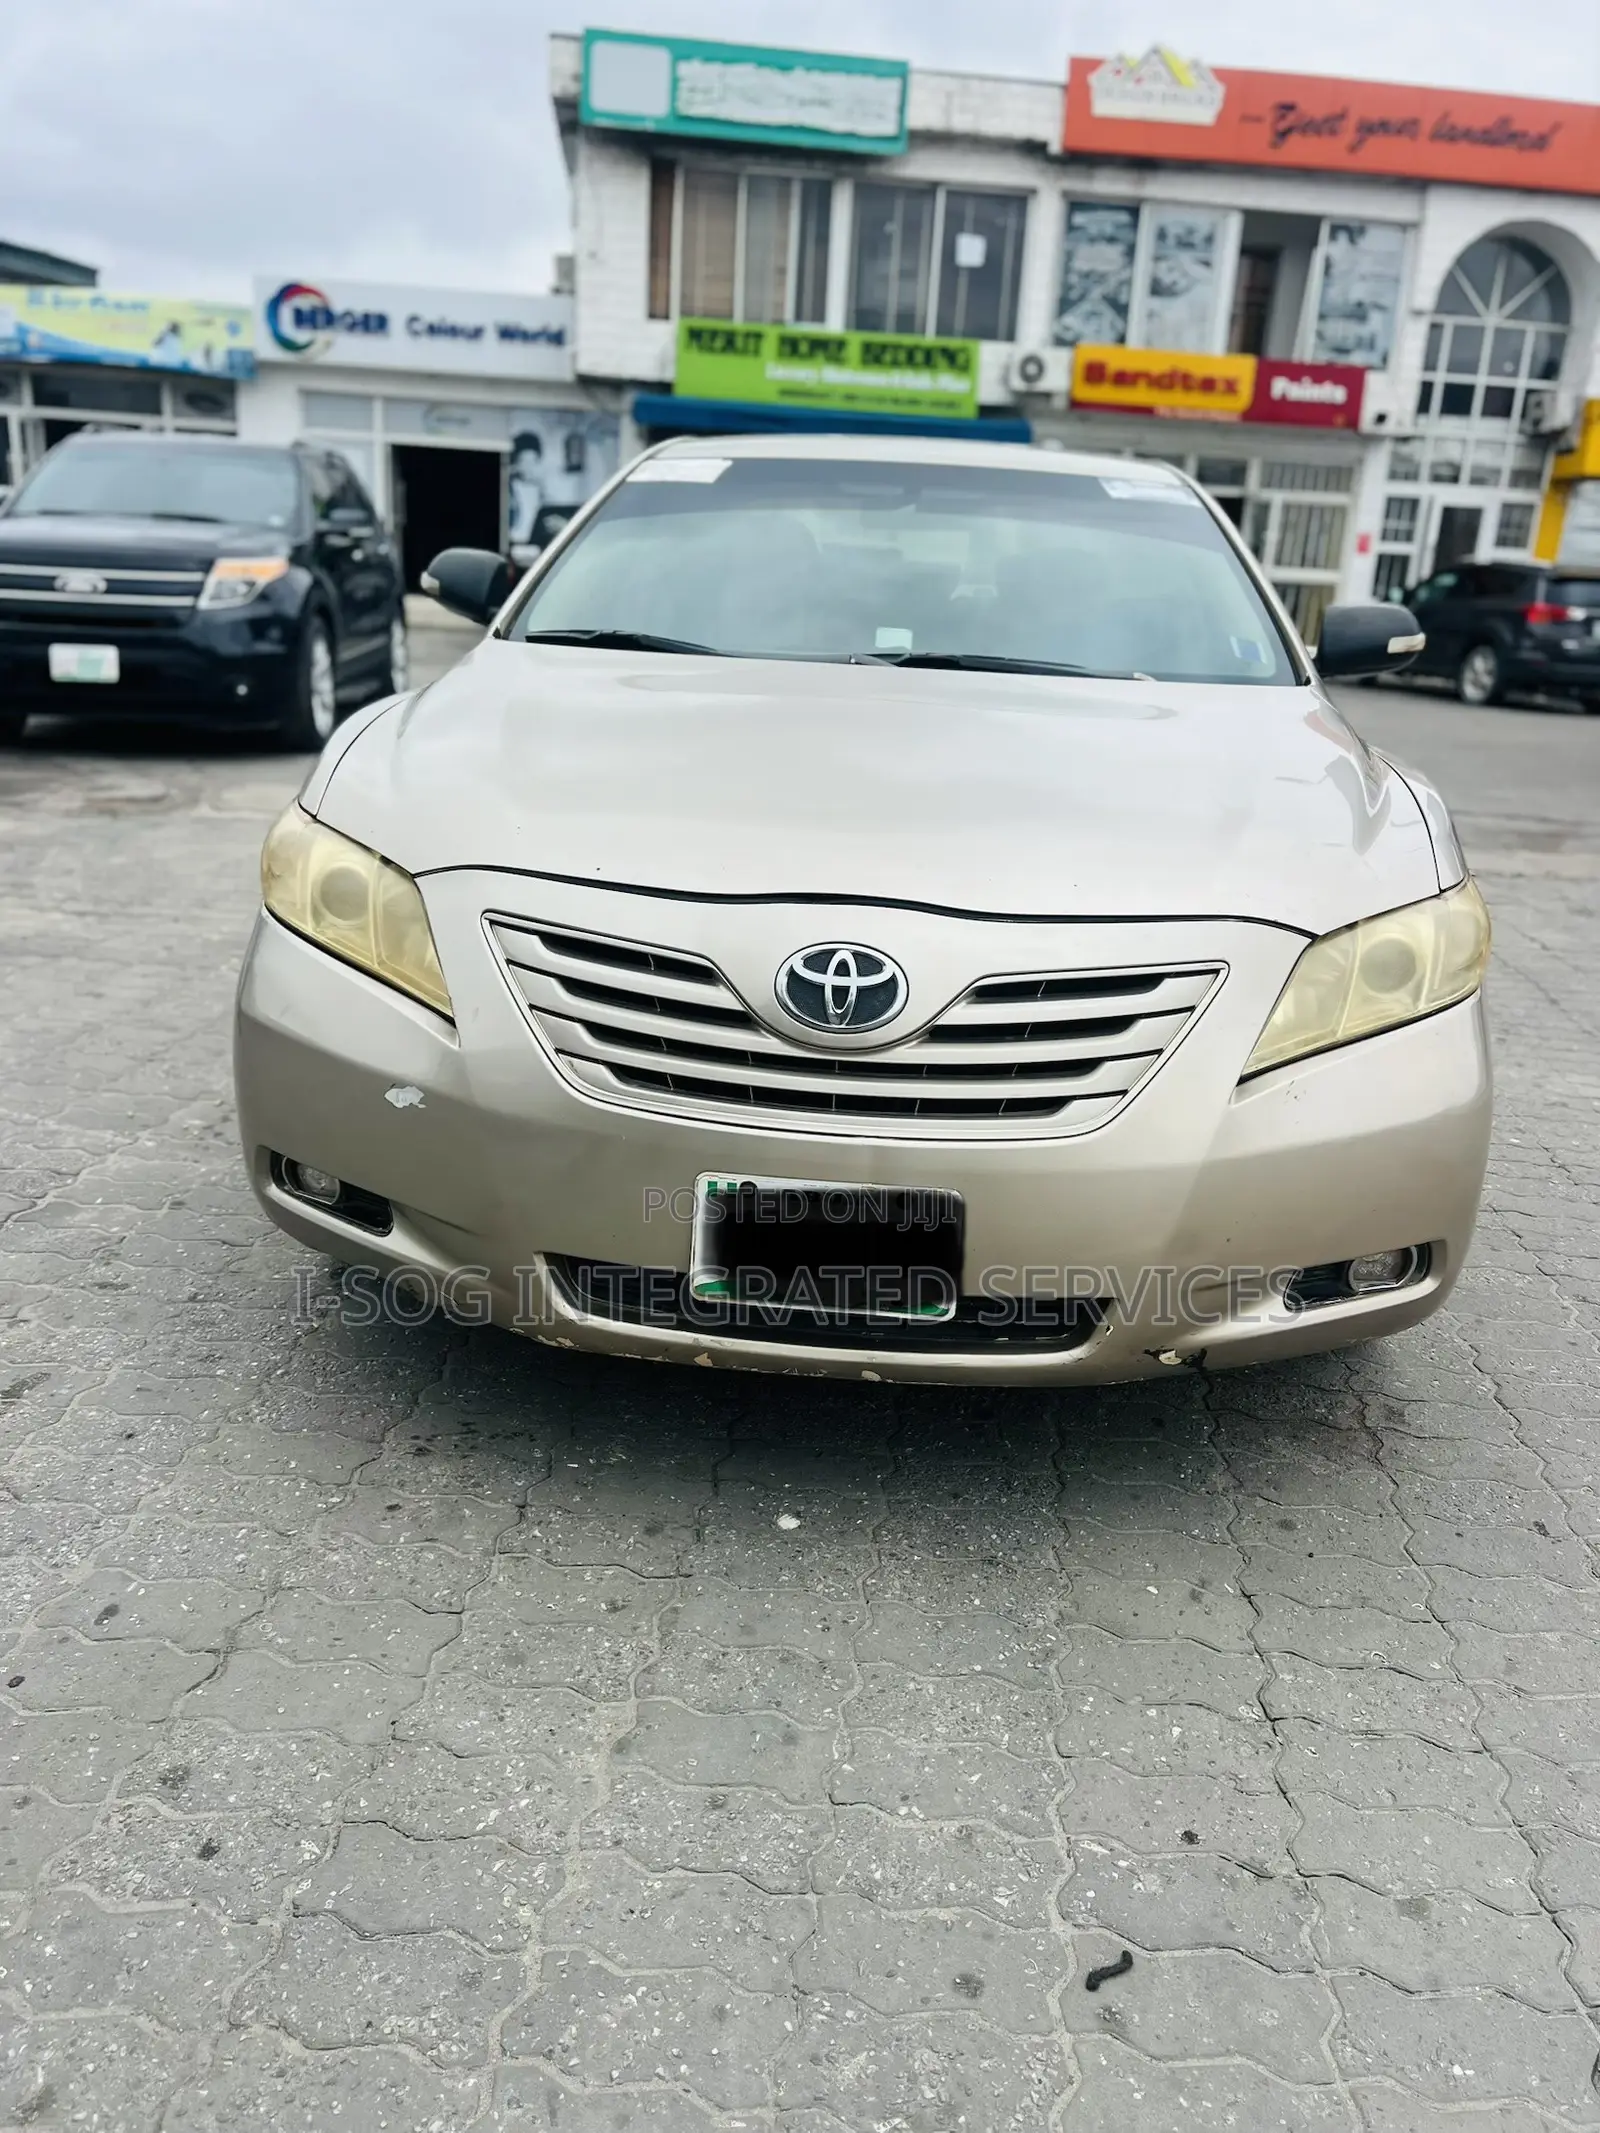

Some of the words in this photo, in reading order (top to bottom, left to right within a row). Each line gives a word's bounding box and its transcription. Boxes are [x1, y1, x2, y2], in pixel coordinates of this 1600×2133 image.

[1346, 117, 1420, 153] your
[294, 306, 389, 335] BERGER
[406, 314, 485, 341] Colour
[496, 322, 566, 346] World
[686, 325, 764, 357] MERIT
[777, 333, 847, 363] HOME
[861, 340, 971, 372] BEDDING
[1270, 375, 1348, 405] Paints
